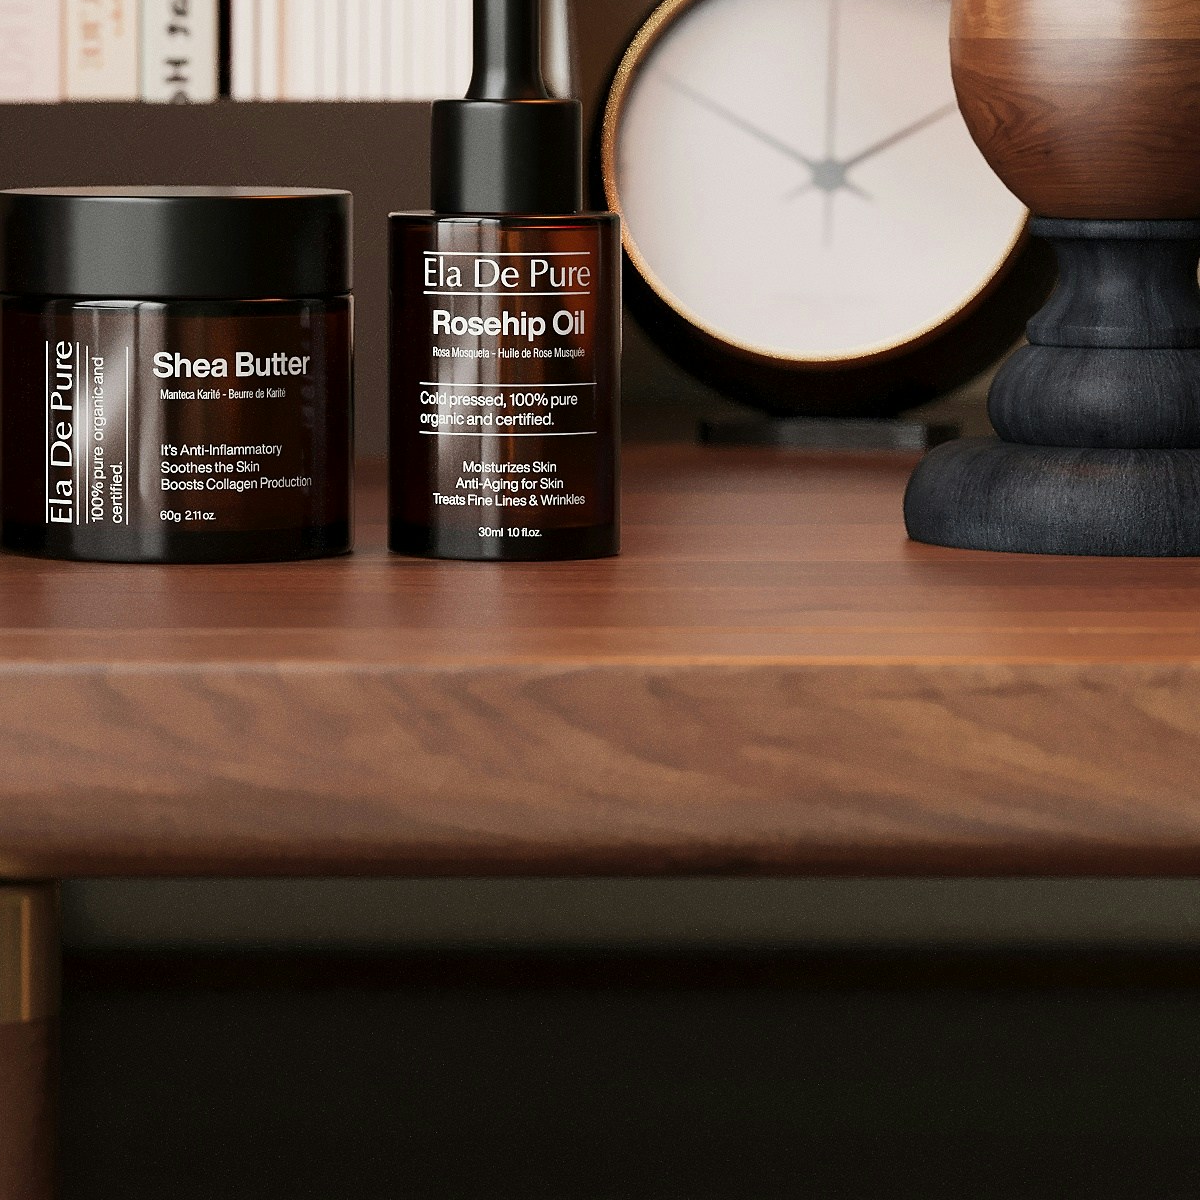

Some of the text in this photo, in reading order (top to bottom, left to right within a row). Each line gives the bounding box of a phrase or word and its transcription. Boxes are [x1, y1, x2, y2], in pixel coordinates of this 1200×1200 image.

[424, 256, 591, 288] Ela De Pure
[432, 309, 585, 342] Rosehip Oil
[432, 346, 451, 358] Rosa
[451, 347, 490, 360] Mosqueta
[498, 347, 520, 358] Huile
[521, 348, 532, 358] de
[533, 348, 553, 358] Rose
[554, 347, 585, 358] Musquée
[153, 351, 311, 378] Shea Butter
[160, 389, 195, 400] Manteca
[197, 388, 221, 400] Karité
[228, 389, 253, 399] Beurre
[255, 389, 265, 398] de
[266, 388, 286, 398] Karité
[420, 391, 578, 408] Cold pressed, 100% pure
[420, 412, 555, 428] organic and certified.
[49, 340, 73, 524] Ela De Pure
[91, 356, 107, 523] 100% pure organic and
[160, 444, 282, 457] It's Anti-Inflammatory
[160, 461, 260, 474] Soothes the Skin
[462, 461, 557, 473] Moisturizes Skin
[160, 476, 312, 493] Boosts Collagen Production
[455, 477, 564, 492] Anti-Aging for Skin
[109, 461, 123, 524] certified.
[432, 493, 586, 507] Treats Fine Lines & Wrinkles
[160, 510, 181, 523] 60g
[478, 526, 504, 538] 30ml
